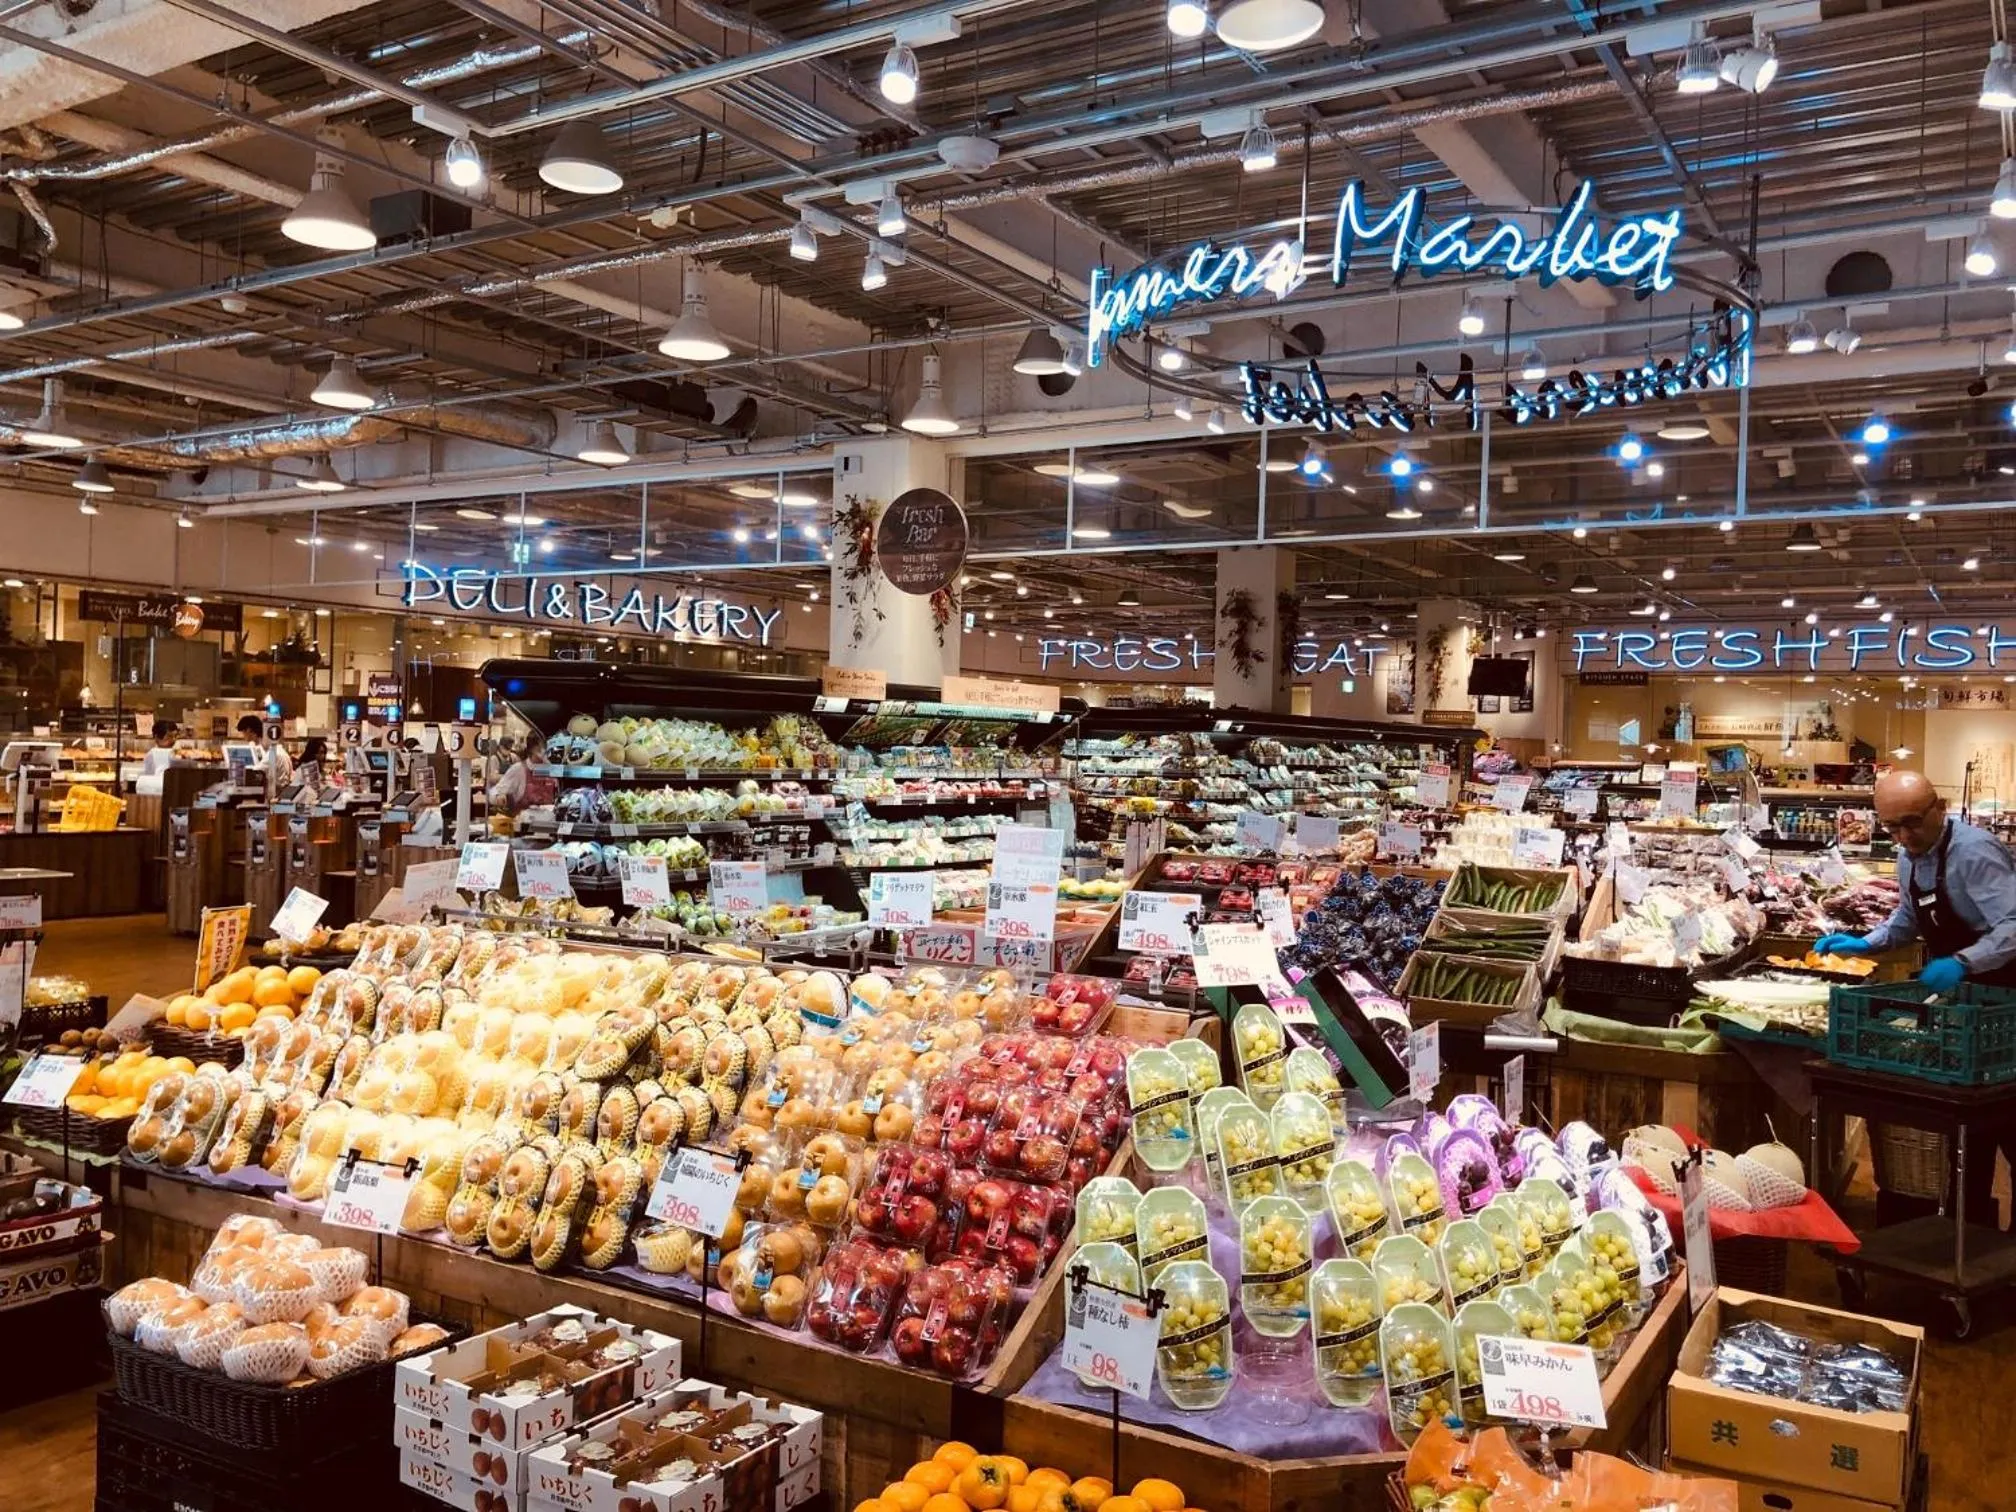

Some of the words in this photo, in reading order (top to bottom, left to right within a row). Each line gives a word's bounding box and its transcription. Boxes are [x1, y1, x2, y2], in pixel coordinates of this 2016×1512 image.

[1332, 179, 1682, 293] Market
[1292, 642, 1389, 677] EAT
[1571, 628, 1831, 671] FRESH
[270, 728, 278, 739] 1
[348, 728, 358, 742] 2
[389, 729, 398, 742] 4
[999, 921, 1030, 937] 398
[1136, 932, 1169, 950] 498
[926, 945, 972, 962] りんご
[1214, 967, 1250, 983] 798
[339, 1206, 374, 1227] 398
[664, 1199, 700, 1225] 398
[1088, 1304, 1130, 1330] 種なし柿
[405, 1382, 449, 1413] いちじく
[1510, 1391, 1562, 1419] 498
[405, 1424, 450, 1456] いちじく
[1710, 1418, 1739, 1447] 共
[1829, 1442, 1860, 1473] 選
[409, 1461, 453, 1493] いちじく
[540, 1474, 593, 1504] いちじく
